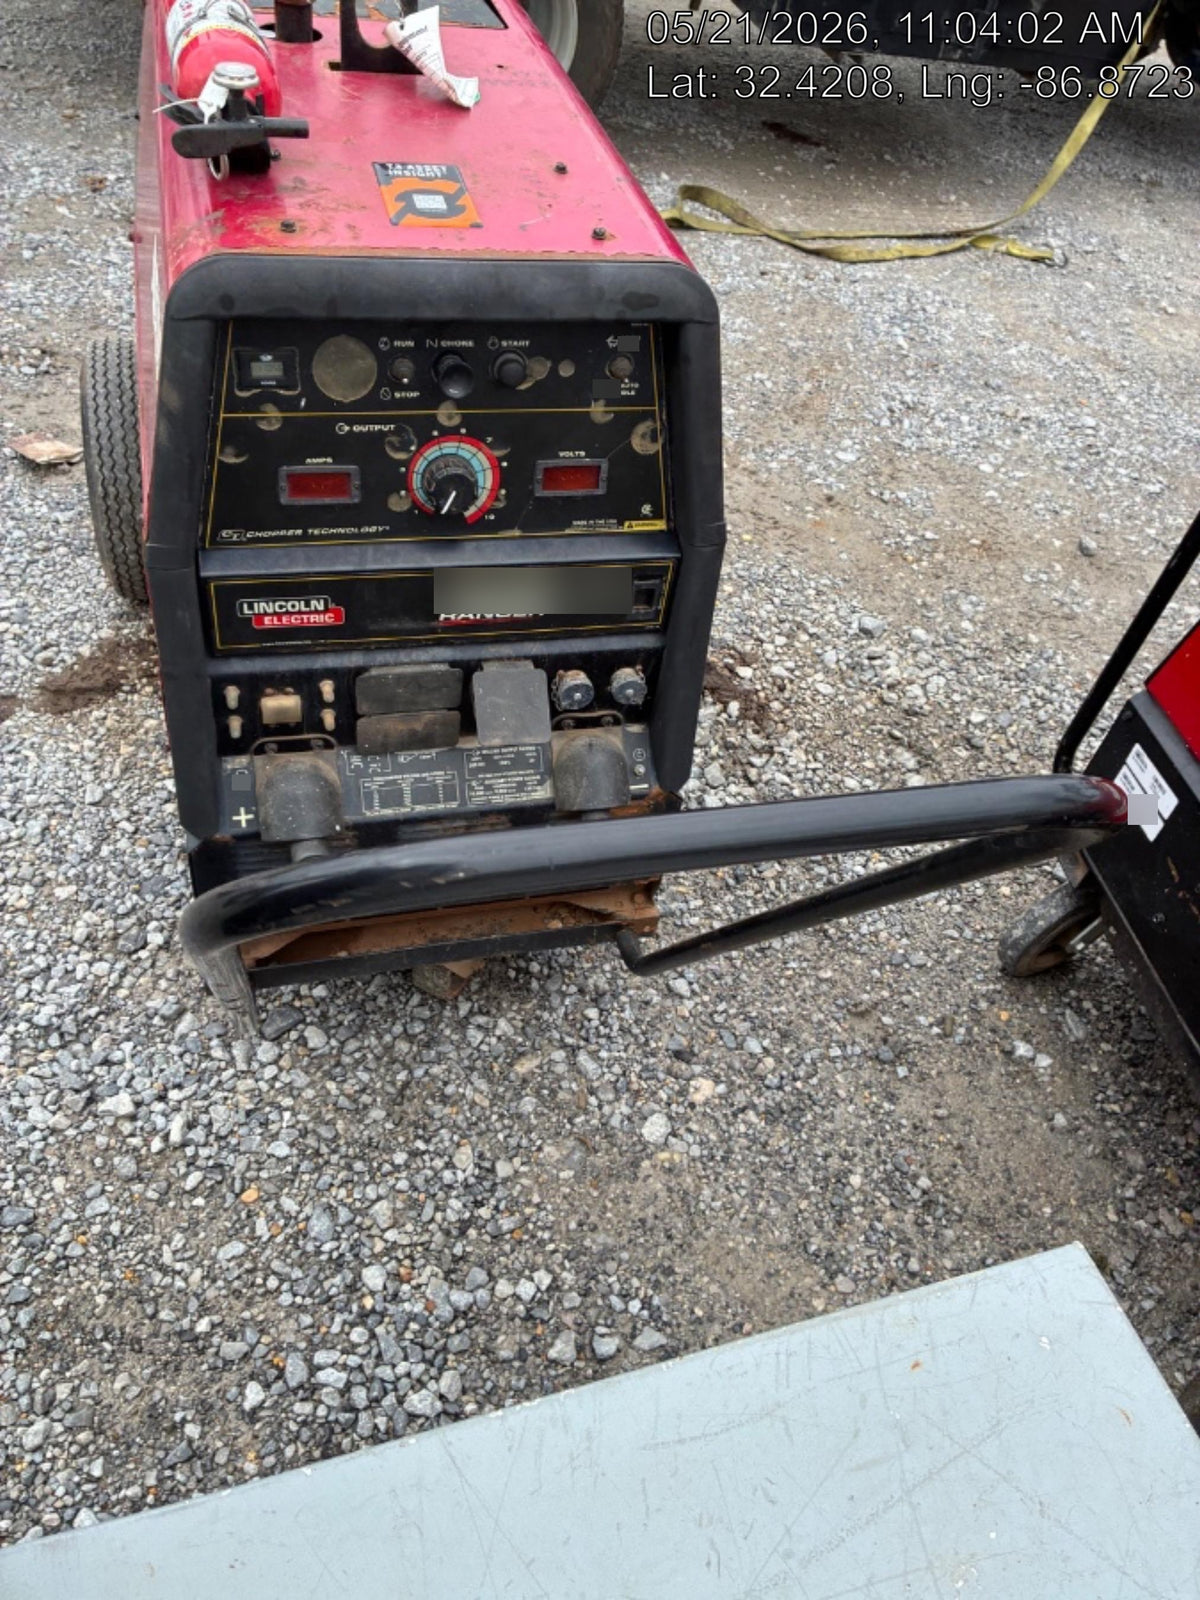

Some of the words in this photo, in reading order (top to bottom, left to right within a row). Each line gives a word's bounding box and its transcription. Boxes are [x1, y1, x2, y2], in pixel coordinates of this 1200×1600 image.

[393, 340, 415, 348] RUN
[440, 339, 475, 348] CHOKE
[501, 339, 530, 348] START
[394, 391, 421, 399] STOP
[352, 424, 396, 433] OUTPUT
[558, 451, 586, 459] VOLTS
[305, 457, 334, 465] AMPS
[246, 528, 304, 539] CHOPPER
[242, 598, 326, 615] LINCOLN
[263, 612, 336, 626] ELECTRIC
